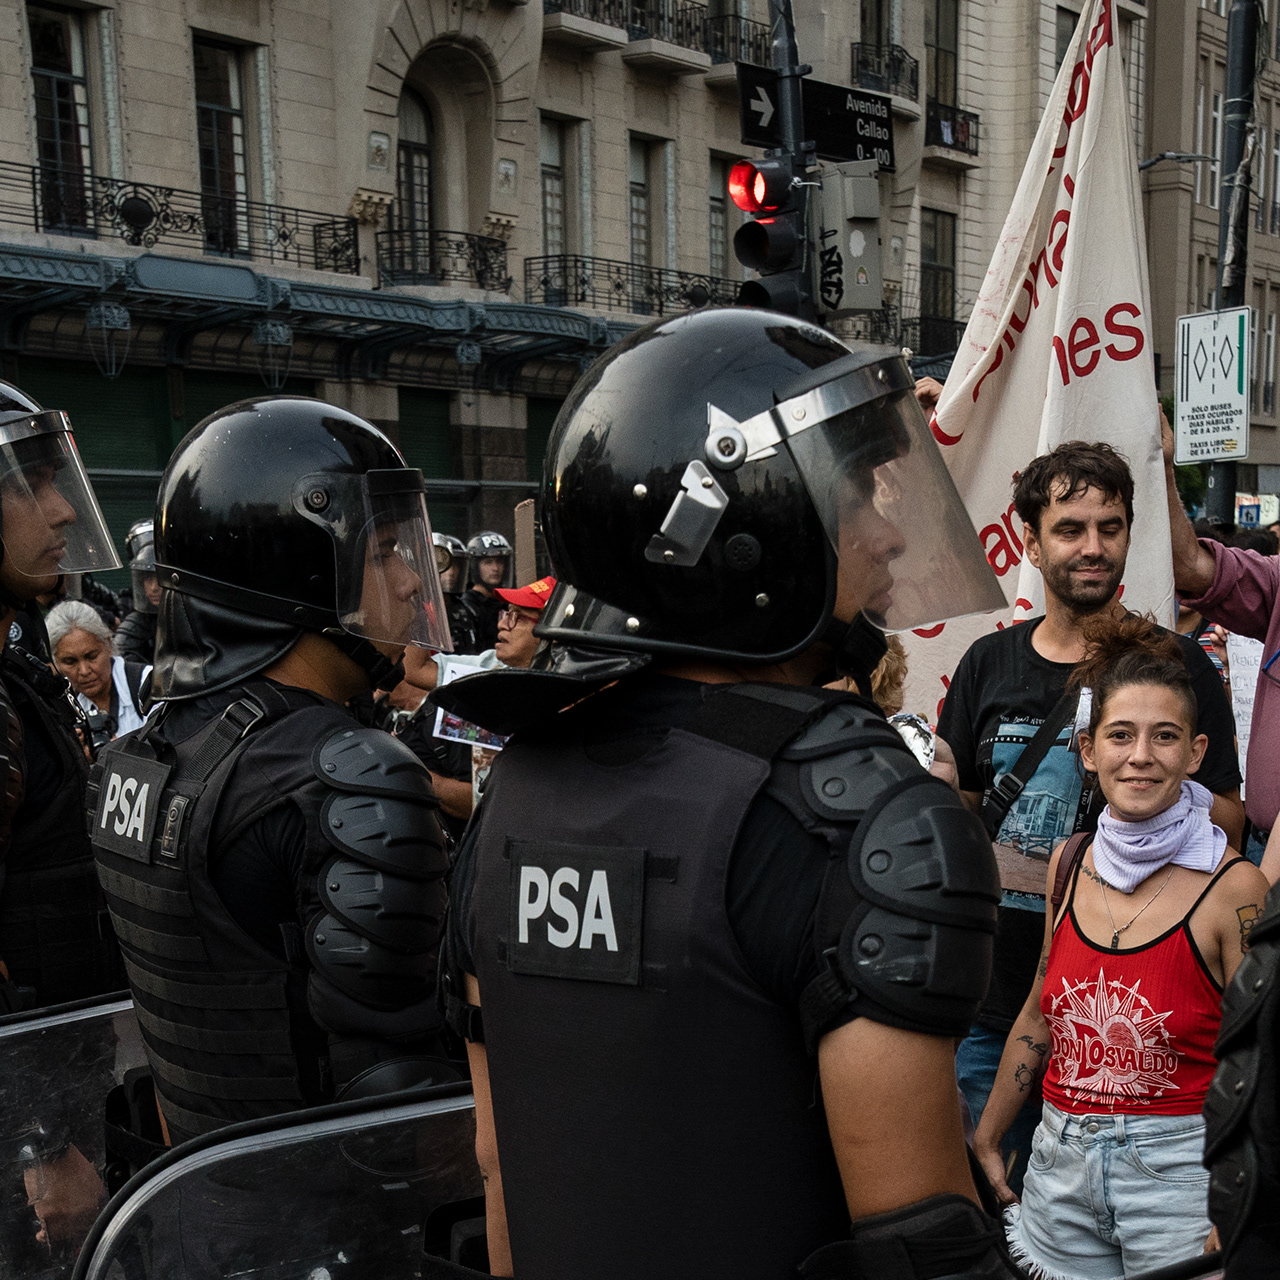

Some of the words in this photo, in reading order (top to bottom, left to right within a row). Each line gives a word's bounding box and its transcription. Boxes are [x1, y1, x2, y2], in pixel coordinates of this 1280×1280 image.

[846, 93, 888, 118] Avenida
[856, 118, 889, 140] Callao
[856, 144, 864, 160] 0
[873, 147, 890, 165] 100
[1187, 413, 1206, 421] TAXIS
[1207, 409, 1243, 419] OCUPADOS
[1210, 403, 1232, 411] BUSES
[1210, 439, 1233, 447] LIBR
[100, 772, 150, 842] PSA
[518, 865, 619, 952] PSA
